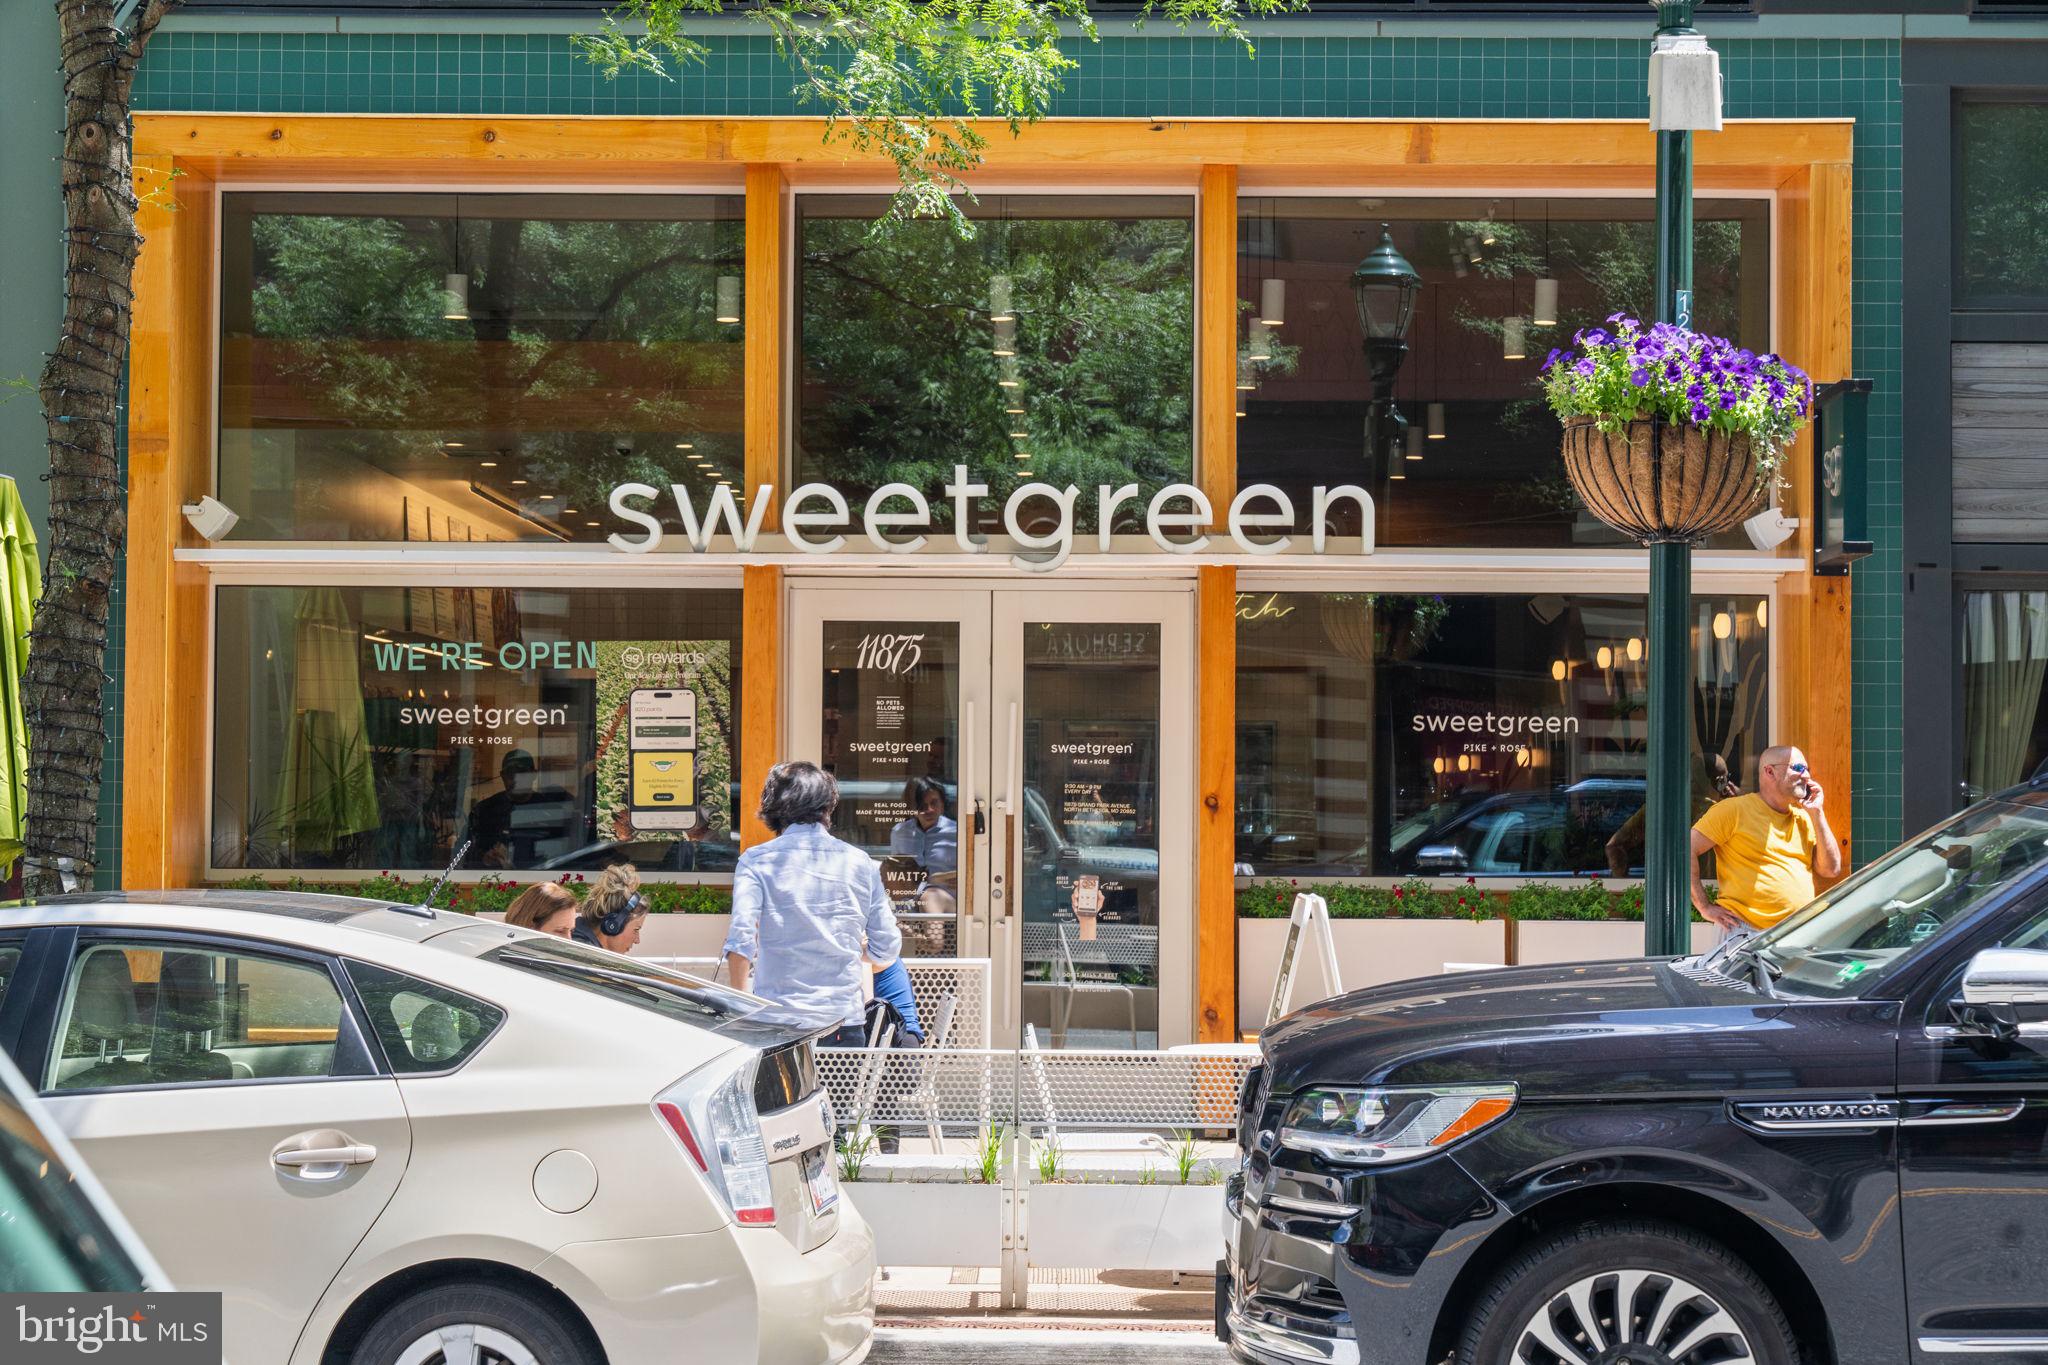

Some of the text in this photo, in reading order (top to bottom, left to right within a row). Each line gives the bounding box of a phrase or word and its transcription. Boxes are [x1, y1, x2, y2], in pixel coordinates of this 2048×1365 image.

[607, 464, 1376, 573] sweetgreen
[373, 640, 597, 672] WE'RE OPEN
[647, 649, 705, 664] rewards
[856, 633, 925, 675] 11875
[399, 704, 567, 729] sweetgreen
[1412, 711, 1579, 737] sweetgreen
[450, 736, 474, 745] PIKE
[487, 736, 513, 745] ROSE
[849, 741, 931, 754] sweetgreen
[1463, 743, 1487, 752] PIKE
[1500, 744, 1526, 753] ROSE
[1050, 742, 1132, 755] sweetgreen
[1763, 1104, 1891, 1117] NAVIGATOR
